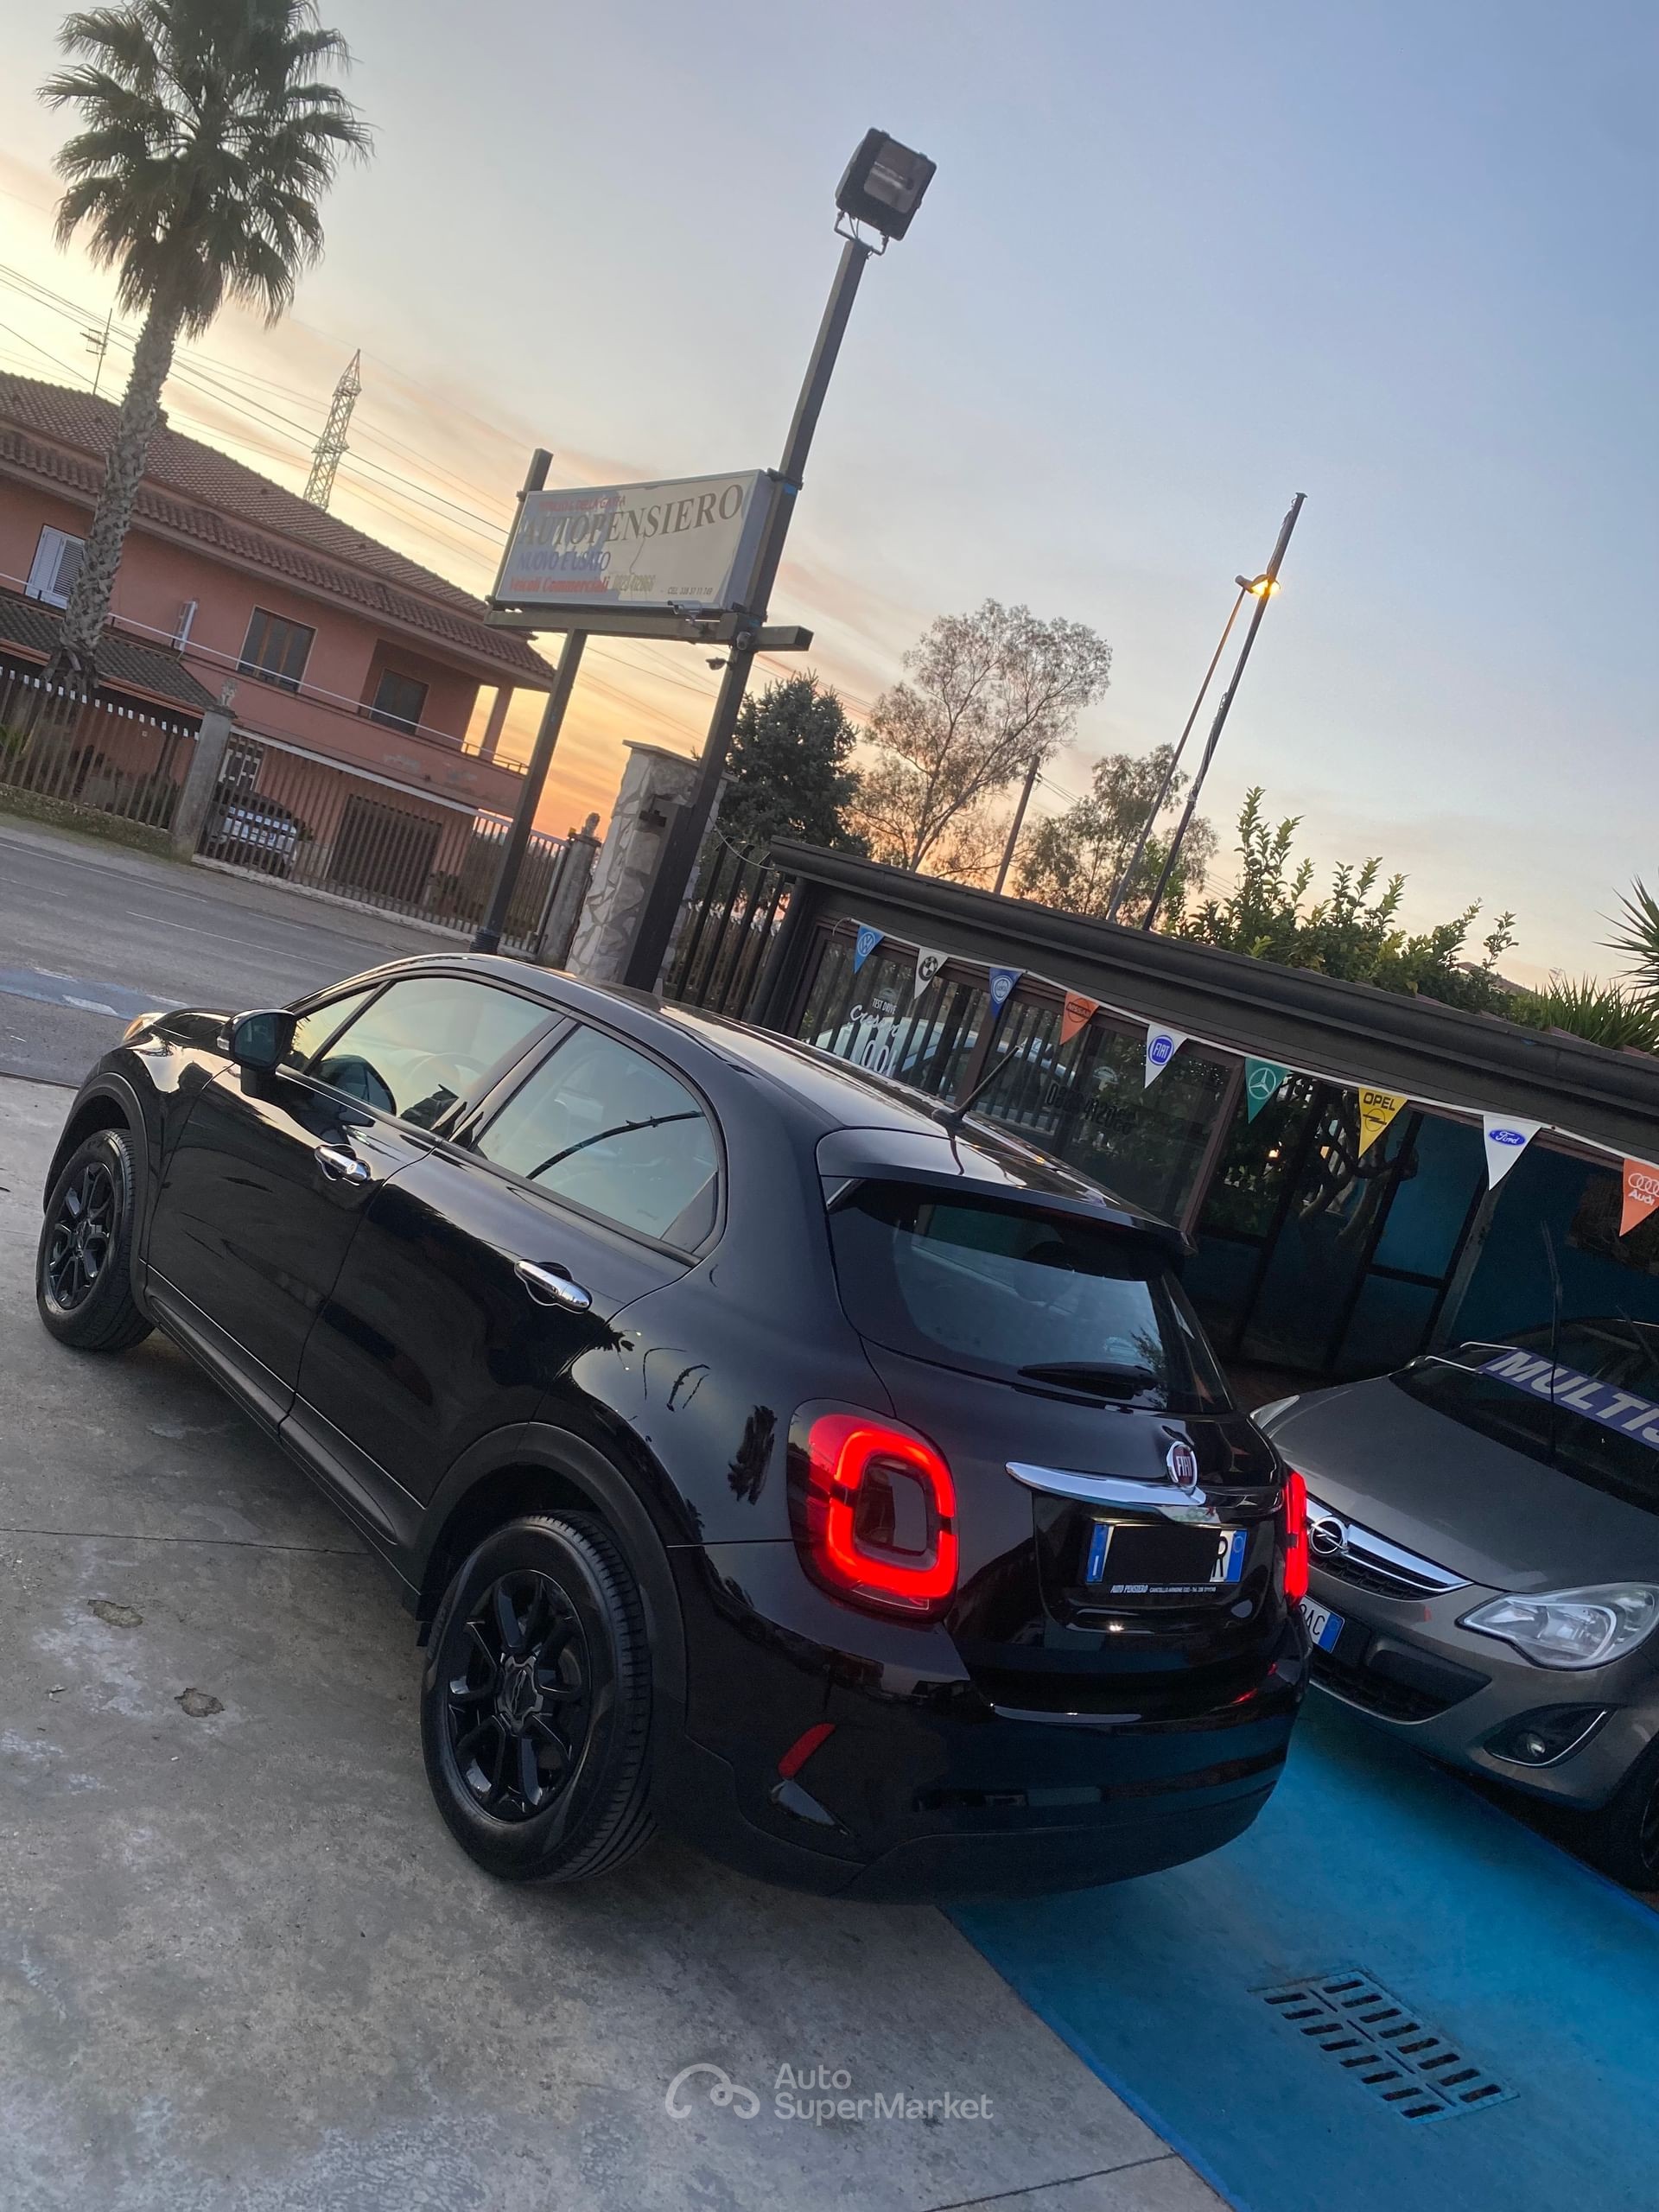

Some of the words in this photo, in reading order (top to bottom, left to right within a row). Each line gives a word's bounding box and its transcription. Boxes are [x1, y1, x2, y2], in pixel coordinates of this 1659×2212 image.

[518, 484, 744, 546] AUTOPENSIERO
[518, 550, 560, 571] NUOVO
[872, 998, 883, 1010] TEST
[881, 1001, 898, 1014] DRIVE
[1153, 1042, 1171, 1059] FIAT
[1363, 1091, 1395, 1112] OPEL
[1495, 1129, 1520, 1145] Ford
[1628, 1188, 1656, 1206] Audi
[1175, 1455, 1192, 1477] FIAT
